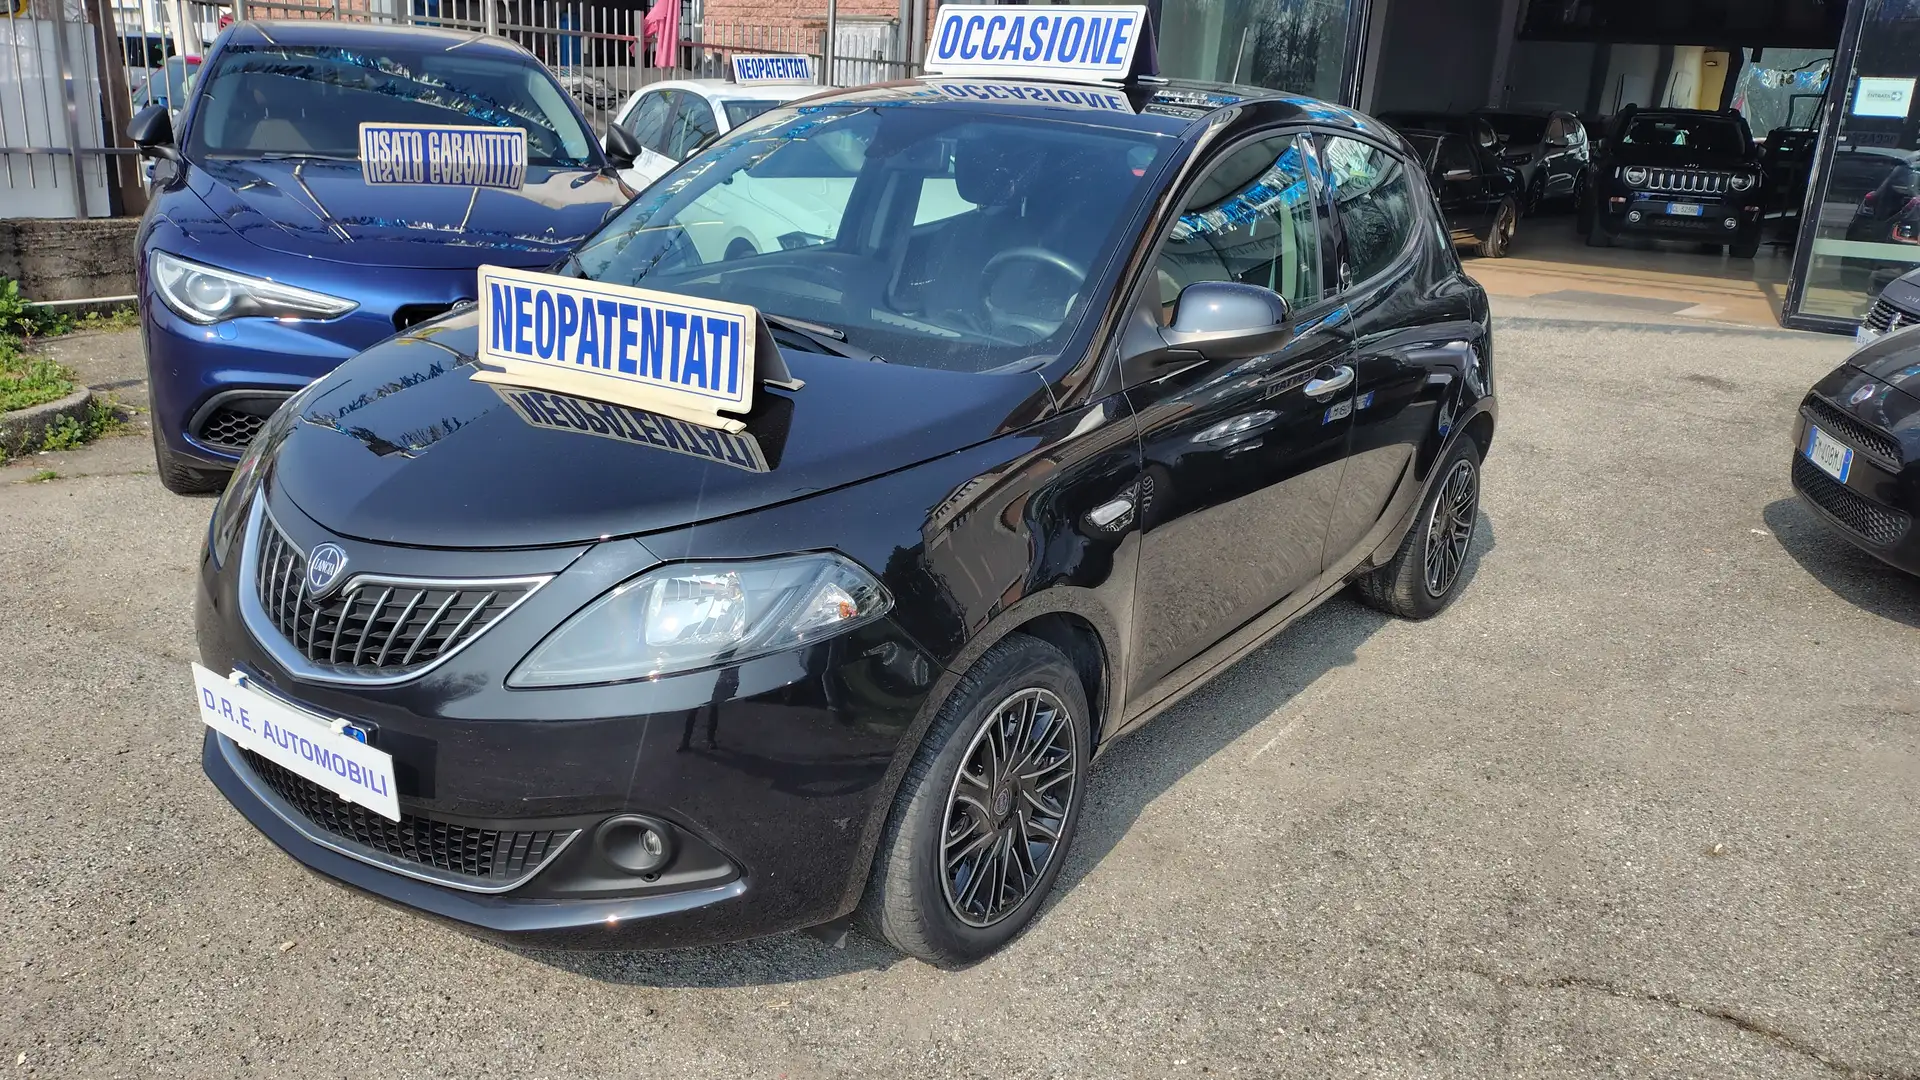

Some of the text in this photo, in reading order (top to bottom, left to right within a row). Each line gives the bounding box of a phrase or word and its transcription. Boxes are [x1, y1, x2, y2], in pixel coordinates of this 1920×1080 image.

[938, 15, 1133, 65] OCCASIONE
[736, 58, 809, 79] NEOPATENTATI
[367, 130, 522, 166] USATO GARANTITO
[491, 282, 740, 394] NEOPATENTATI
[313, 558, 336, 576] LANCIA
[202, 687, 388, 798] D.R.E. AUTOMOBILI
